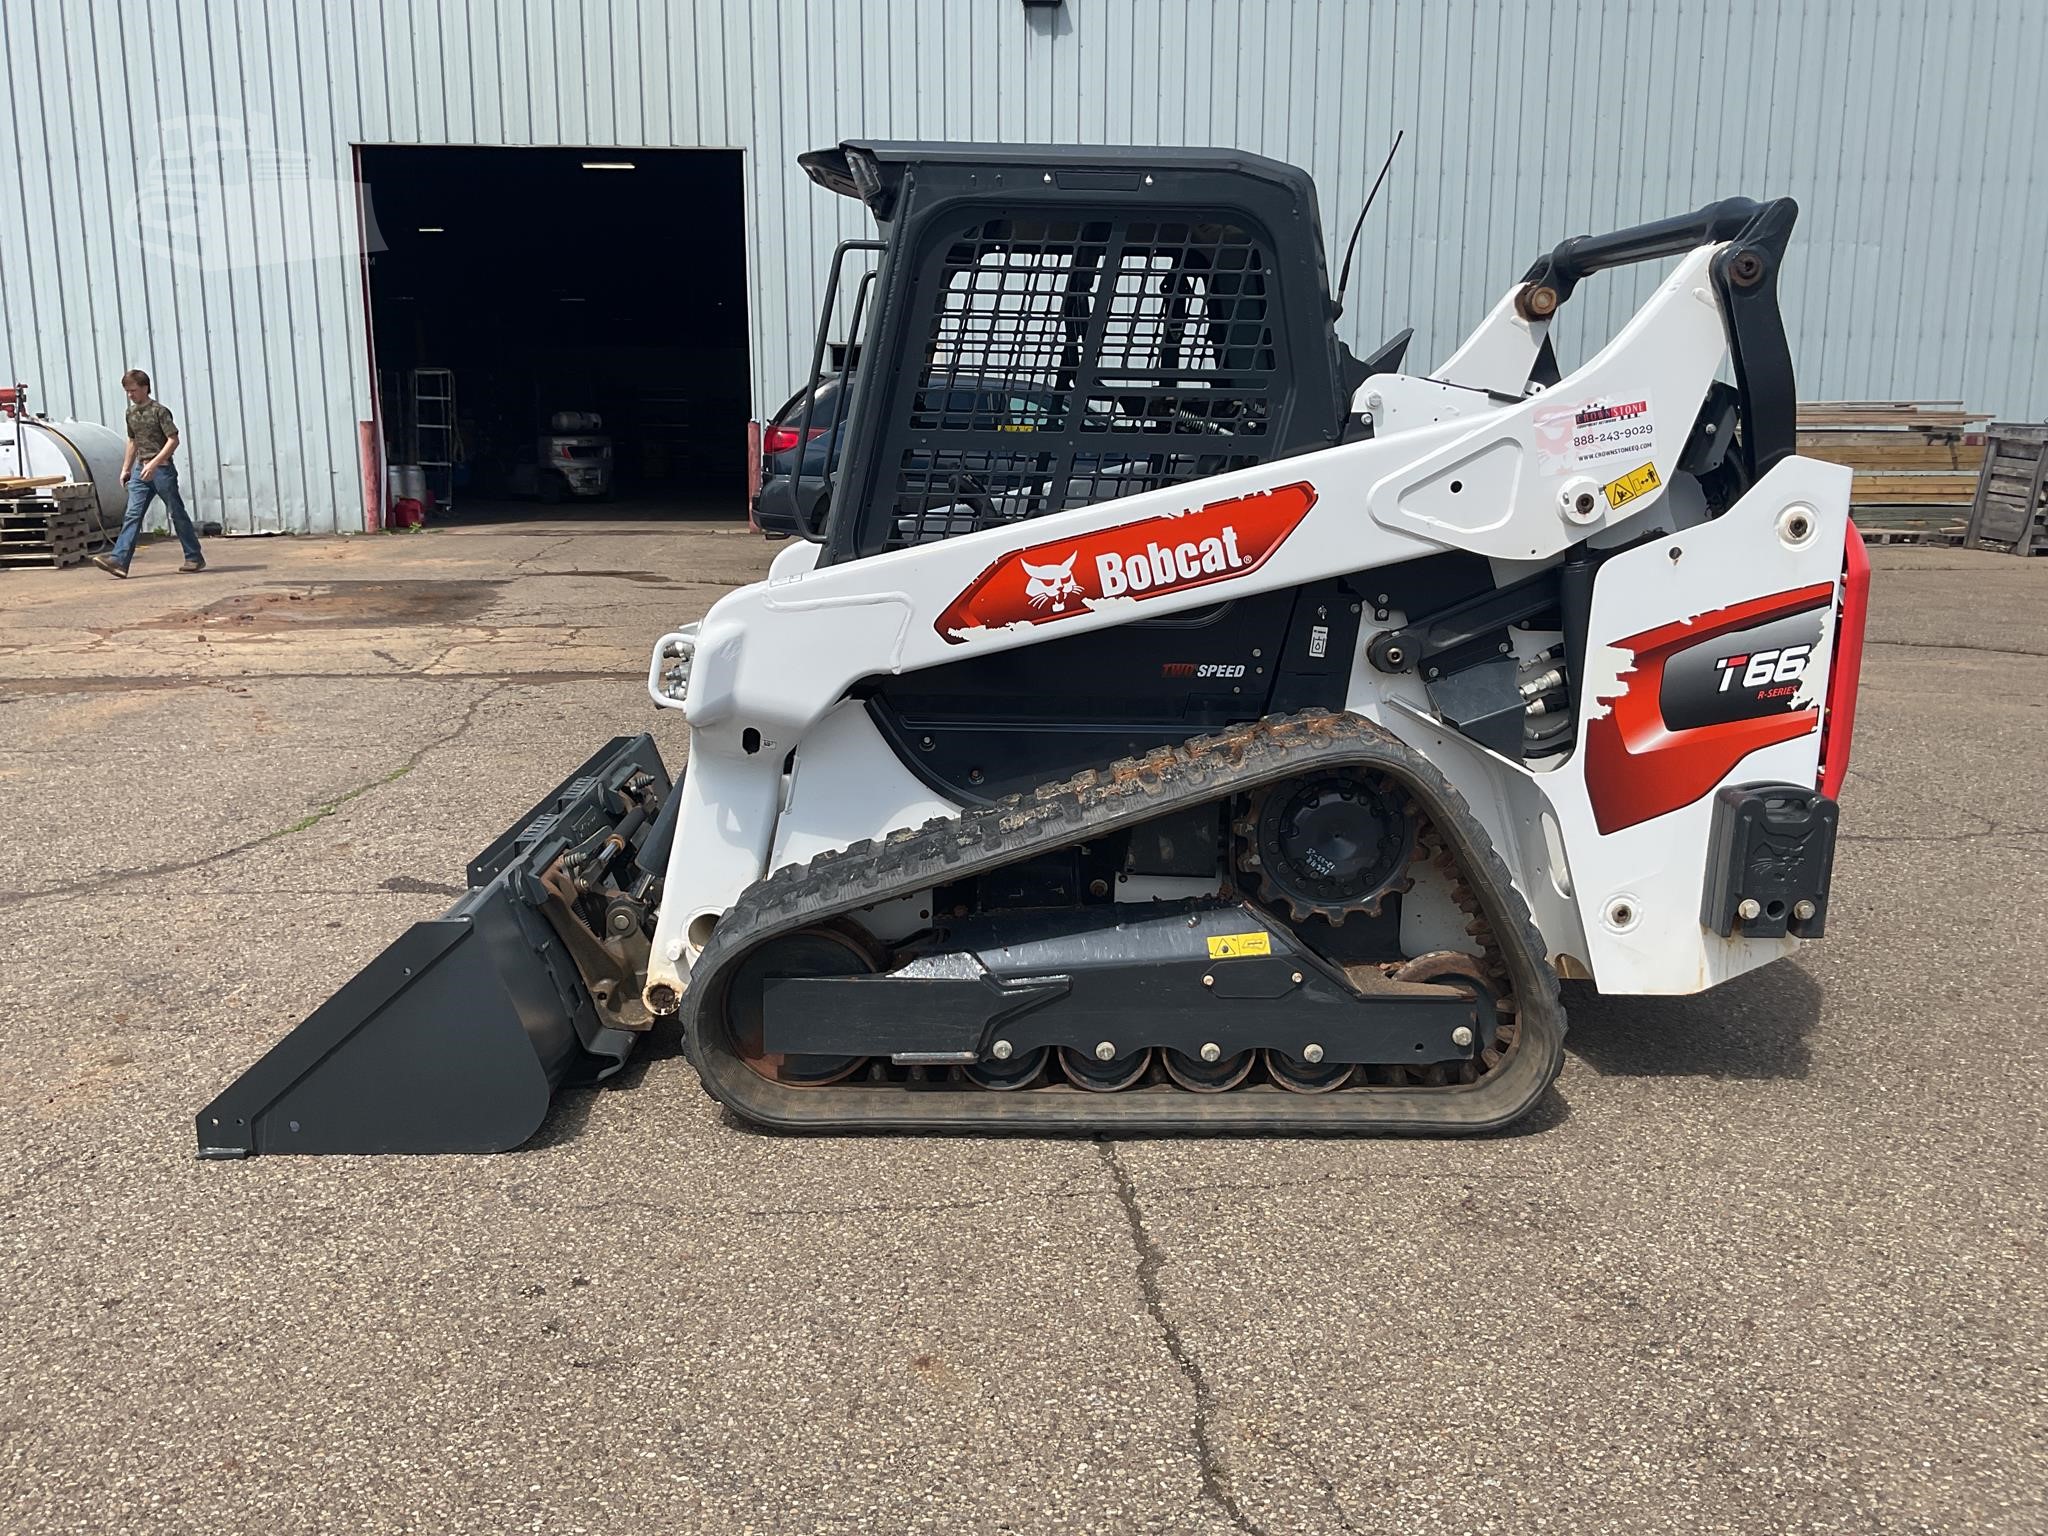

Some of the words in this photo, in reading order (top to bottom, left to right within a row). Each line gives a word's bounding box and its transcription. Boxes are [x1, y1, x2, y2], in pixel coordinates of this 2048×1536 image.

[1573, 424, 1653, 447] 888-243-9029
[1578, 442, 1652, 461] WWW.CROWNSTONEEQ.COM
[1095, 526, 1243, 598] Bobcat
[1197, 664, 1246, 678] SPEED
[1716, 645, 1811, 692] T66
[1757, 685, 1798, 700] R-SERIES
